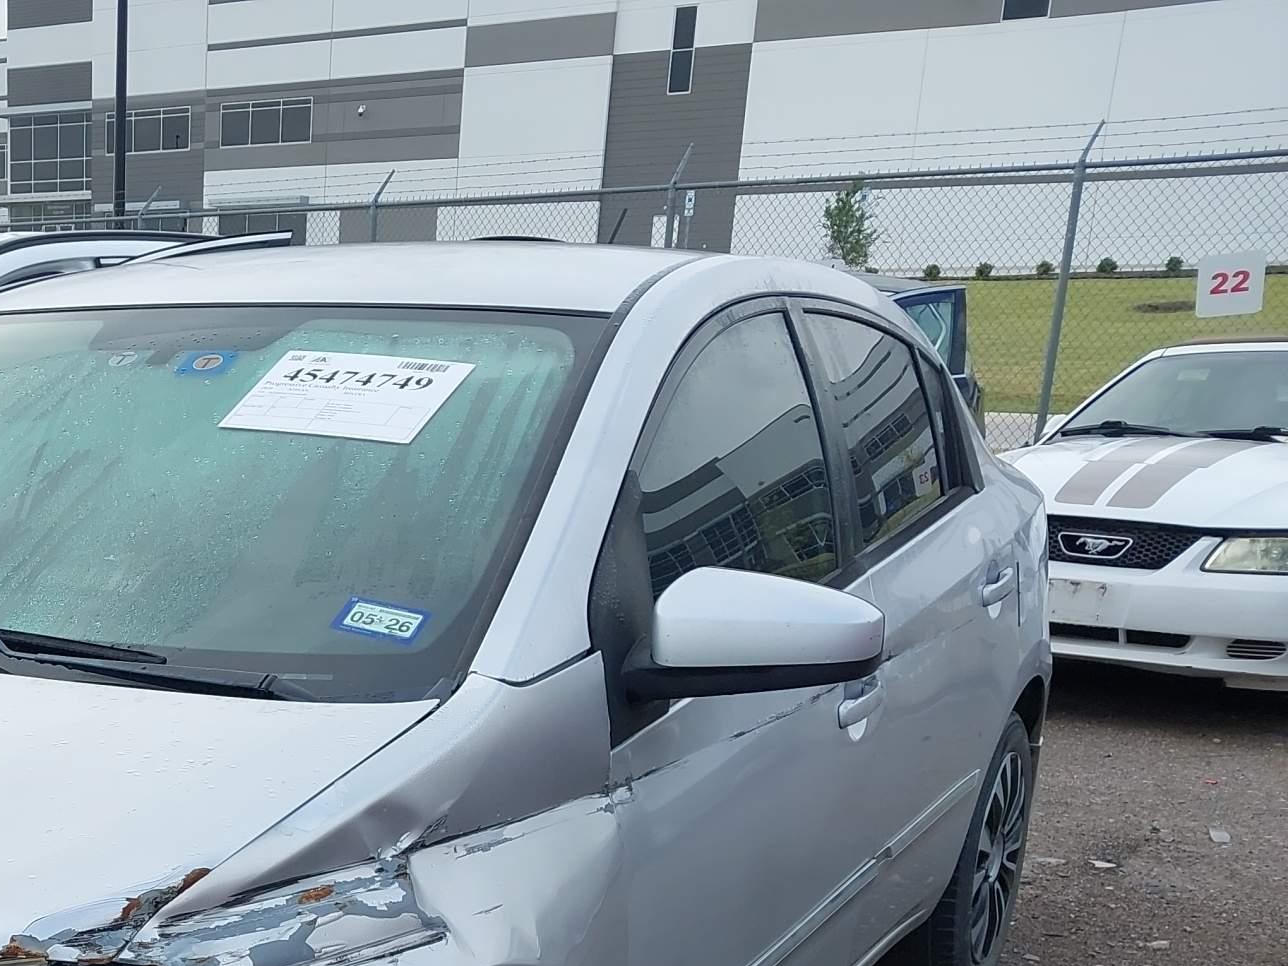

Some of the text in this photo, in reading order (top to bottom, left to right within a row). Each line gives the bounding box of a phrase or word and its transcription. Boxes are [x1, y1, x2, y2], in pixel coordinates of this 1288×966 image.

[1210, 270, 1250, 295] 22
[283, 367, 434, 391] 45474749
[350, 611, 377, 625] 05
[384, 618, 414, 633] 26
